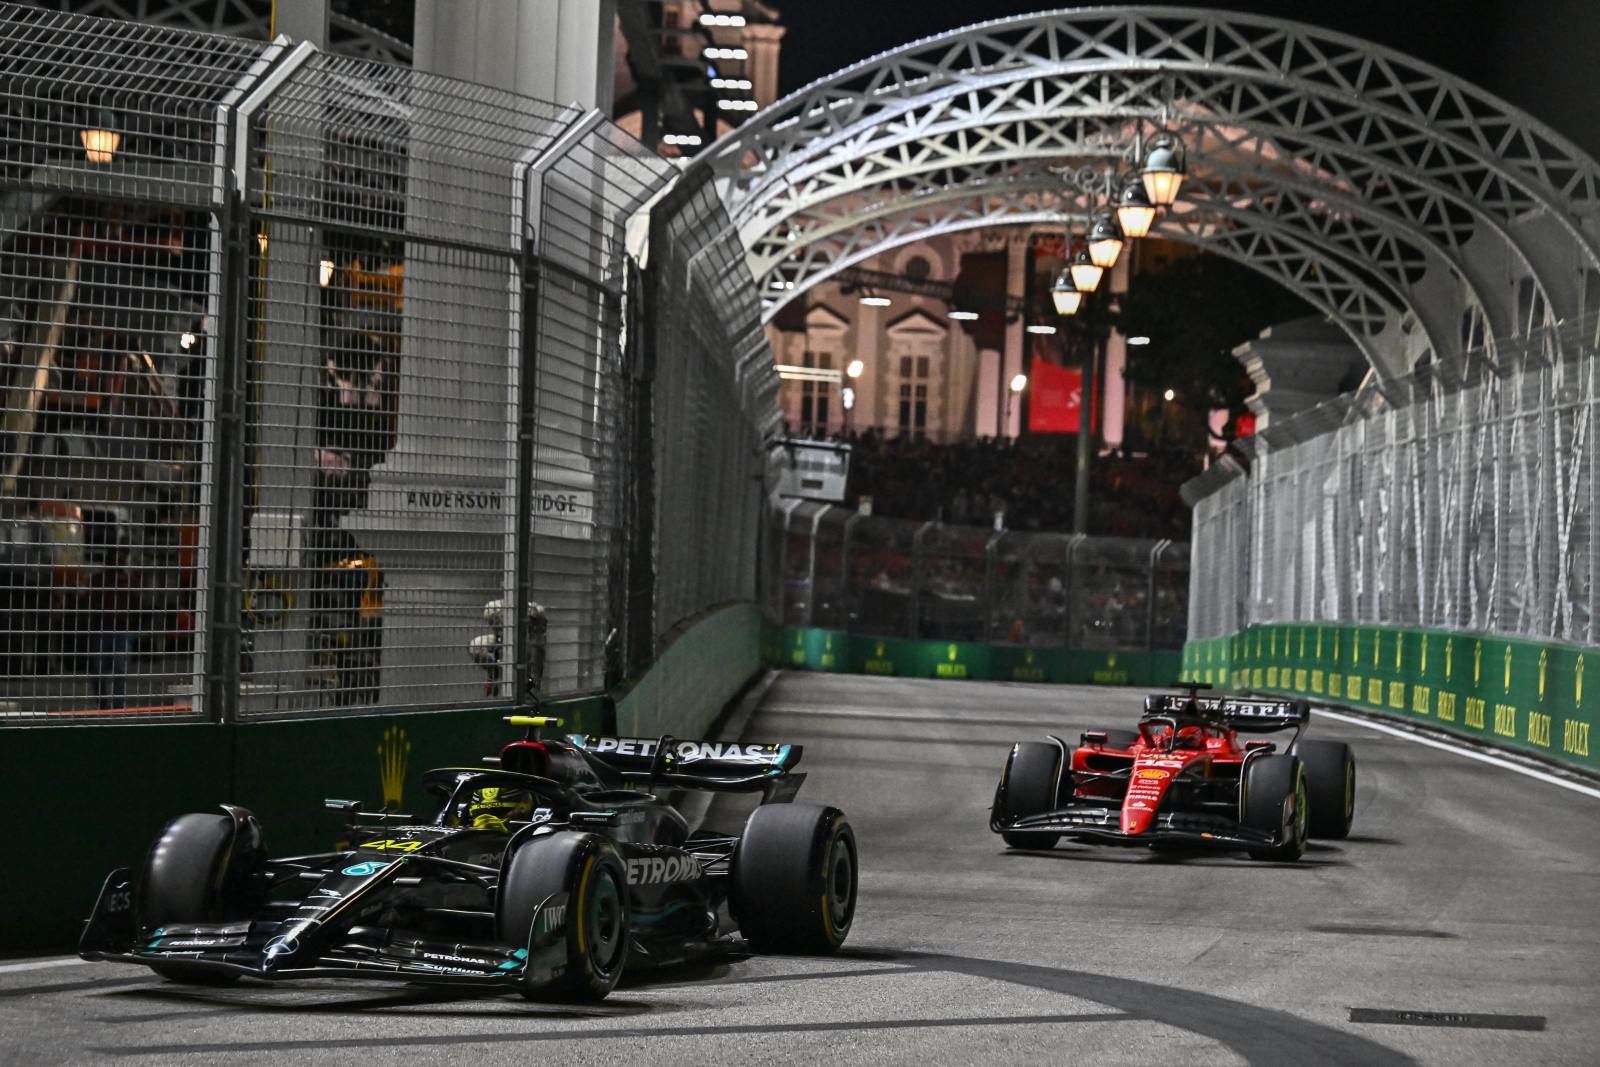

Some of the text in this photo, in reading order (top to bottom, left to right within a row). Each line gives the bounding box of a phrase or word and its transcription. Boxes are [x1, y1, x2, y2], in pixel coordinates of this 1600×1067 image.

[407, 489, 501, 510] ANDERSON
[1494, 704, 1516, 737] ROLEX
[1528, 711, 1551, 747] ROLEX
[597, 737, 764, 761] PETONAS
[1563, 719, 1590, 757] ROLEX
[360, 840, 423, 852] 44
[423, 953, 486, 964] PETRONAS
